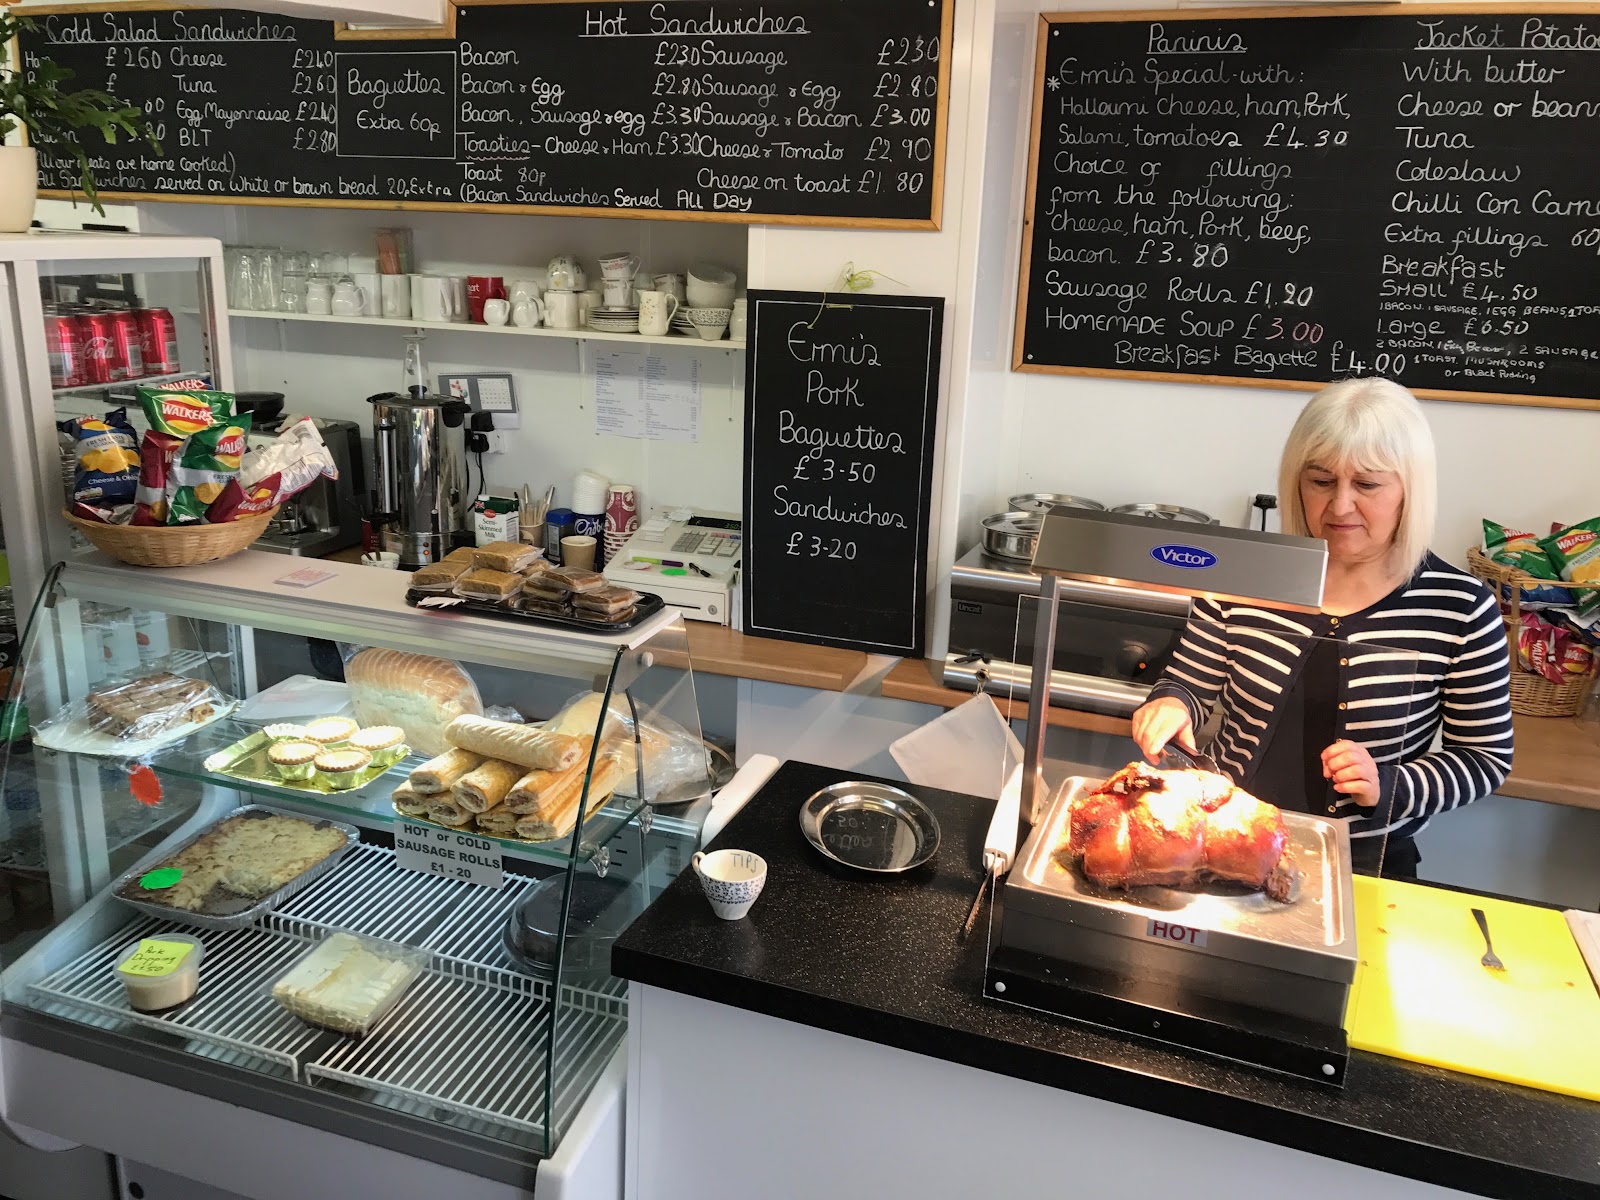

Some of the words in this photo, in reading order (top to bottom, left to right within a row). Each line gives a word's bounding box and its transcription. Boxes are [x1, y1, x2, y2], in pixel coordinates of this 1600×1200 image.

[46, 15, 96, 42] Cold
[103, 12, 161, 41] Salad
[173, 11, 296, 41] Sandwiches
[586, 8, 627, 35] Hot
[650, 3, 811, 34] Sandwiches
[1149, 23, 1247, 52] Paninis
[1416, 19, 1505, 48] Jacket
[170, 46, 227, 67] Cheese
[460, 42, 519, 65] Bacon
[701, 40, 788, 74] Sausage
[1144, 58, 1229, 95] Special
[1402, 57, 1471, 83] With
[1484, 54, 1566, 83] butter
[172, 74, 217, 93] Tuna
[348, 68, 445, 109] Baguettes
[462, 73, 515, 93] Bacon
[531, 77, 565, 105] Egg
[701, 73, 778, 107] Sausage
[801, 80, 841, 111] Egg
[177, 100, 203, 127] Egg
[205, 102, 291, 129] Mayonnaise
[1397, 91, 1484, 117] Cheese
[1493, 101, 1523, 117] or
[357, 110, 404, 130] Extra
[410, 112, 441, 141] 60p
[531, 102, 602, 135] Sausage
[614, 110, 646, 136] egg
[700, 102, 780, 137] Sausage
[797, 106, 862, 127] Bacon
[179, 127, 212, 147] BLT
[456, 131, 530, 154] Toasties
[545, 136, 600, 154] Cheese
[612, 138, 651, 155] Ham
[699, 135, 760, 158] Cheese
[771, 140, 844, 160] Tomato
[1059, 123, 1130, 148] Salami,
[1134, 123, 1242, 147] tomatoes
[1395, 126, 1475, 149] Tuna
[141, 155, 175, 171] home
[456, 162, 502, 181] Toast
[518, 166, 546, 187] 80p
[1054, 151, 1128, 175] Choice
[1141, 160, 1162, 186] of
[1202, 156, 1293, 190] fillings
[1396, 157, 1521, 183] Coleslaw
[154, 173, 203, 190] served
[207, 178, 225, 191] on
[275, 179, 289, 192] or
[293, 177, 333, 195] brown
[339, 175, 379, 195] bread
[697, 167, 761, 190] Cheese
[764, 175, 788, 191] on
[794, 173, 851, 193] toast
[460, 182, 511, 203] (Bacon
[516, 185, 609, 205] Sandwiches
[614, 187, 663, 208] Served
[713, 192, 752, 211] Day
[1046, 187, 1102, 215] from
[1114, 184, 1156, 206] the
[1391, 190, 1463, 214] Chilli
[1476, 191, 1521, 215] Con
[1384, 223, 1445, 244] Extra
[1447, 226, 1549, 258] fillings
[1381, 254, 1506, 285] Breakfast
[1046, 270, 1148, 313] Sausage
[1168, 277, 1237, 303] Rolls
[1377, 318, 1446, 340] Large
[1114, 340, 1221, 369] Breakfast
[1234, 345, 1318, 373] Baguette
[1376, 339, 1385, 348] 2
[1519, 344, 1529, 355] 2
[806, 370, 864, 407] Pork
[162, 403, 215, 423] WALKERS
[779, 410, 906, 459] Baguettes
[88, 476, 115, 485] Cheese
[774, 485, 907, 529] Sandwiches
[484, 531, 496, 539] Milk
[1557, 532, 1599, 550] WALKERS
[1161, 548, 1211, 565] Victor
[404, 824, 429, 838] HOT
[437, 833, 449, 842] or
[457, 835, 491, 851] COLD
[397, 839, 456, 860] SAUSAGE
[459, 852, 500, 869] ROLLS
[730, 853, 758, 874] TIPS
[1153, 920, 1200, 944] HOT
